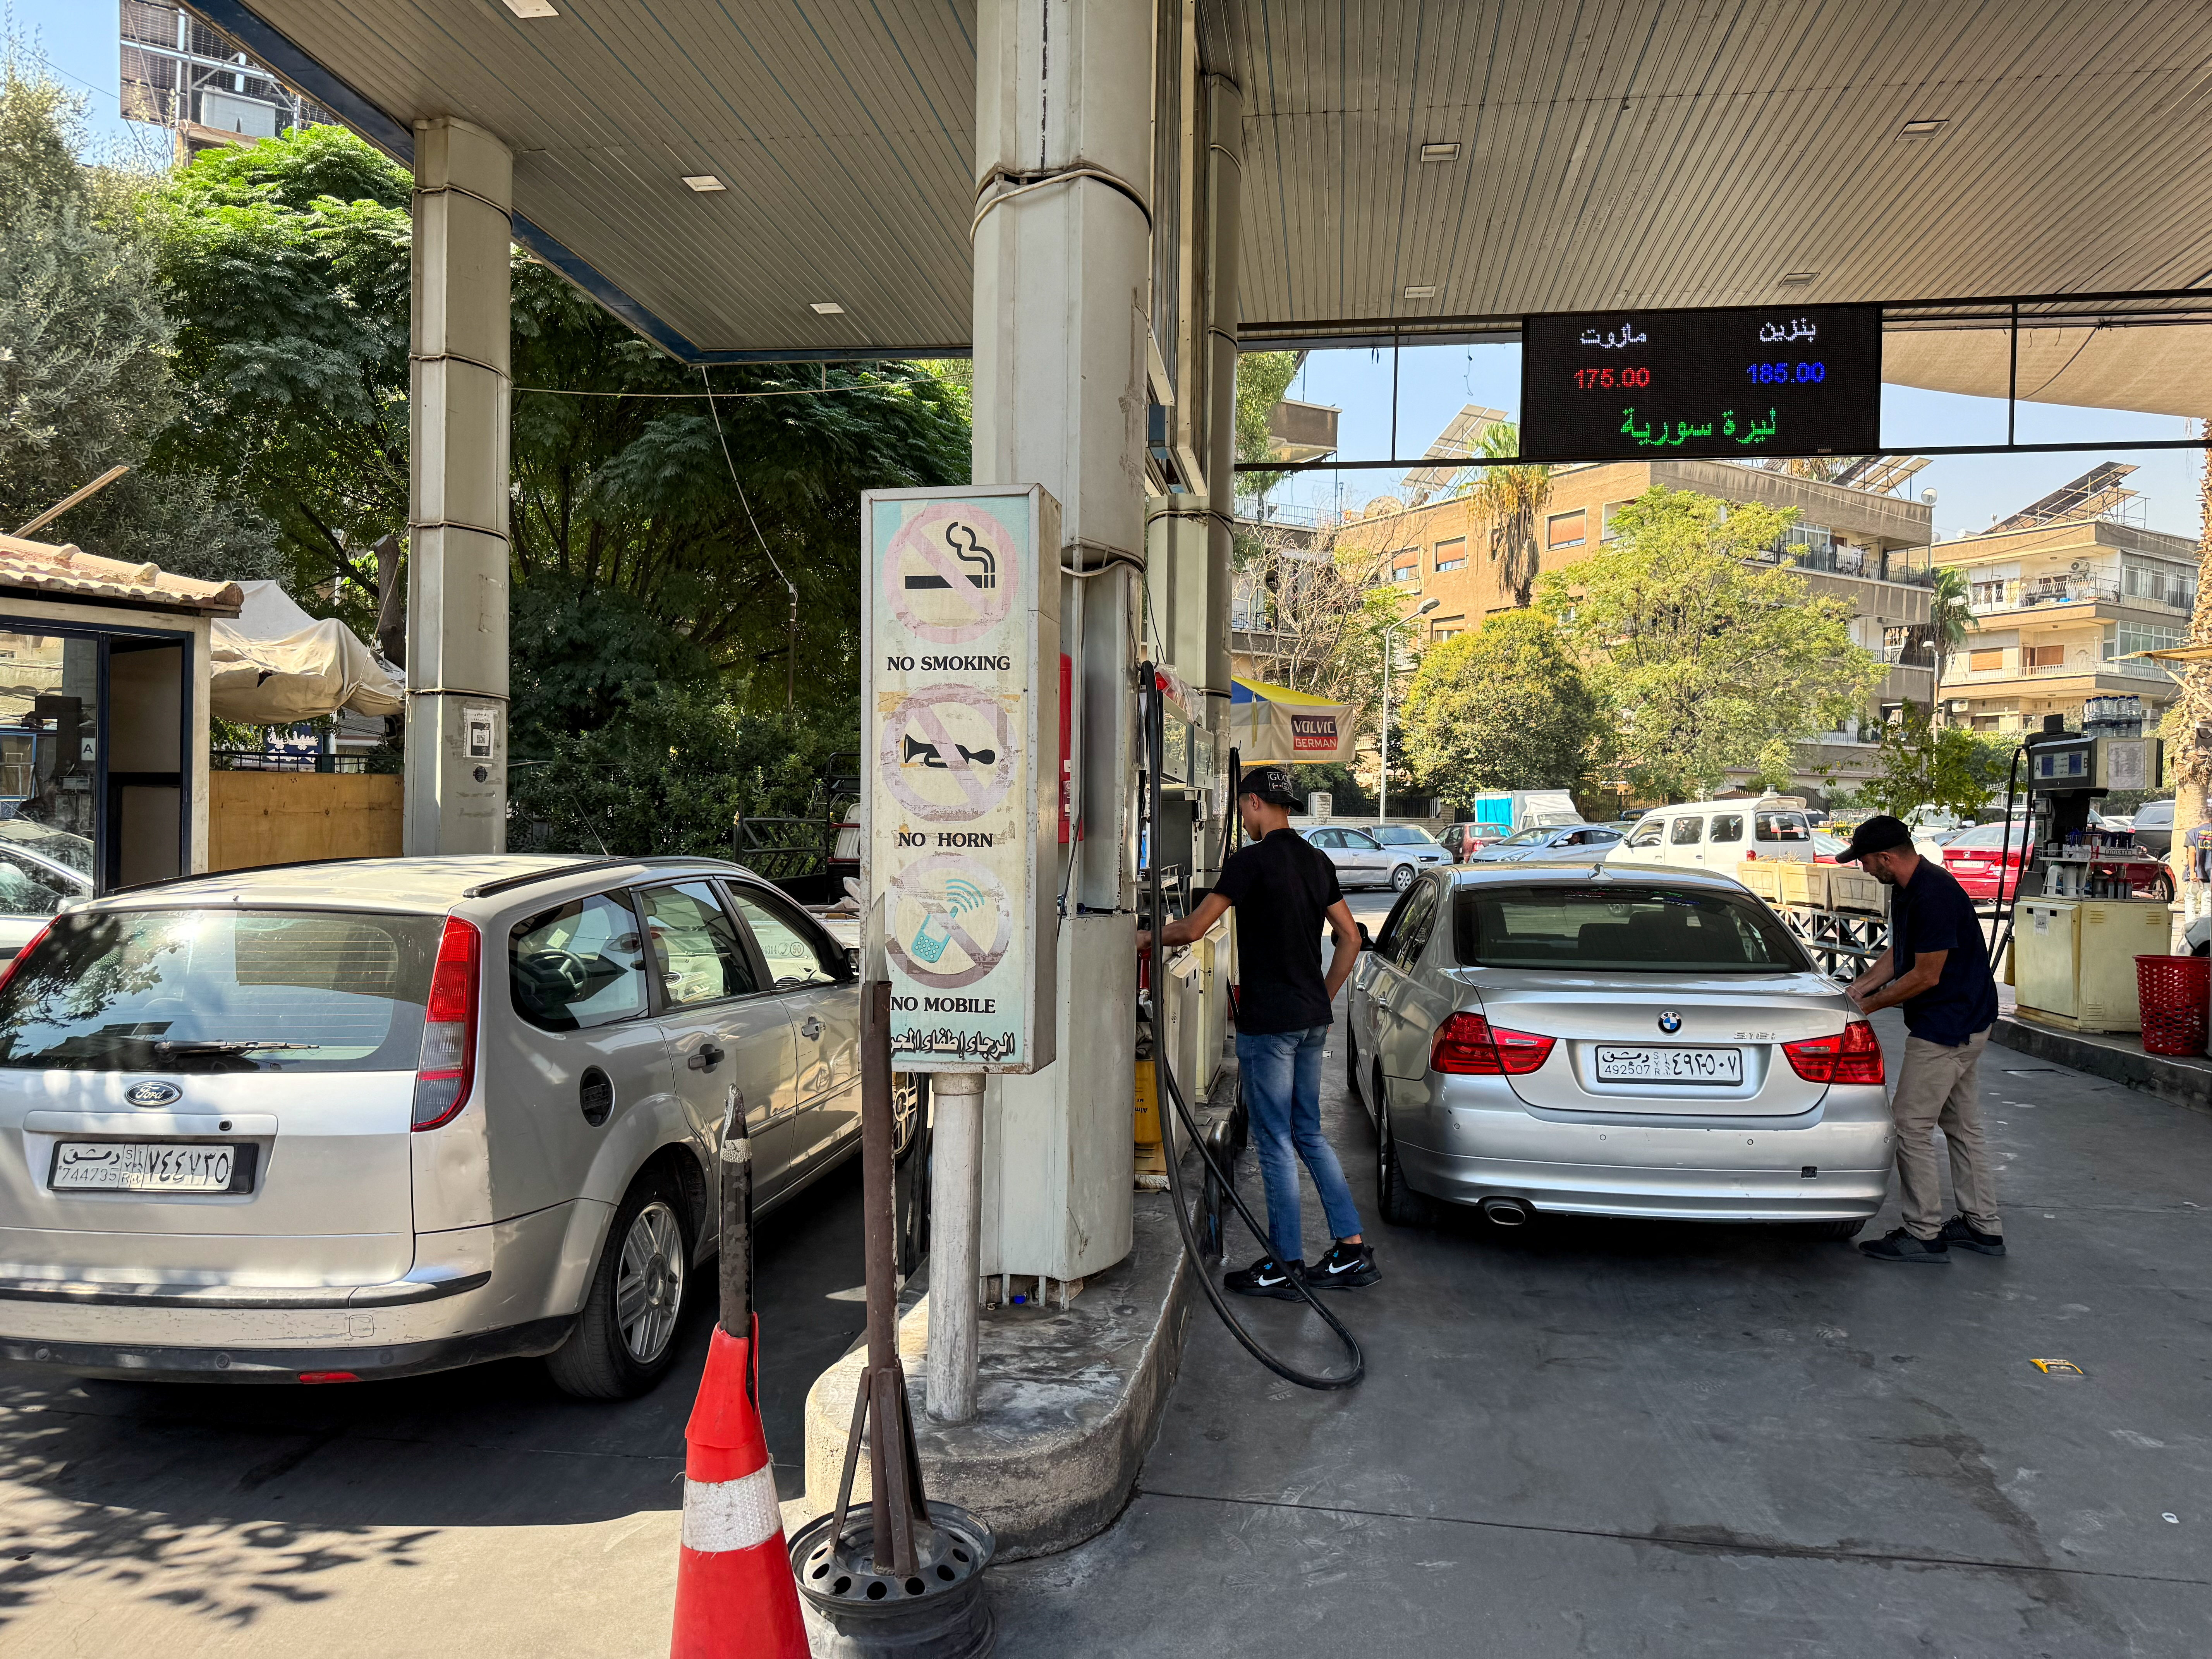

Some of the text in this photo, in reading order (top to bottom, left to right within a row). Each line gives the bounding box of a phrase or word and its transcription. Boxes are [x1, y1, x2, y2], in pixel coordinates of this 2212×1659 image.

[1580, 323, 1646, 348] مازوت
[1760, 318, 1815, 342] بنزين
[1574, 368, 1649, 388] 175.00
[1747, 362, 1825, 383] 185.00
[1621, 408, 1776, 445] ليرة سورية
[888, 656, 1010, 671] NO SMOKING
[1293, 720, 1335, 733] VOLVIC
[83, 744, 93, 754] A
[1295, 738, 1336, 747] GERMAN
[2035, 762, 2040, 772] A
[898, 832, 993, 848] NO HORN
[793, 945, 801, 953] 90
[891, 997, 996, 1013] NO MOBILE
[891, 1027, 1014, 1058] الرجاء إطفاء المحر
[1602, 1051, 1649, 1063] دمشق
[1672, 1053, 1736, 1076] ٤٩٢٥٠٧
[1604, 1065, 1650, 1075] 492507
[136, 1085, 166, 1099] Ford
[63, 1149, 120, 1165] دمشق
[62, 1168, 119, 1182] 744735
[149, 1150, 228, 1186] ٧٤٤٧٣٥
